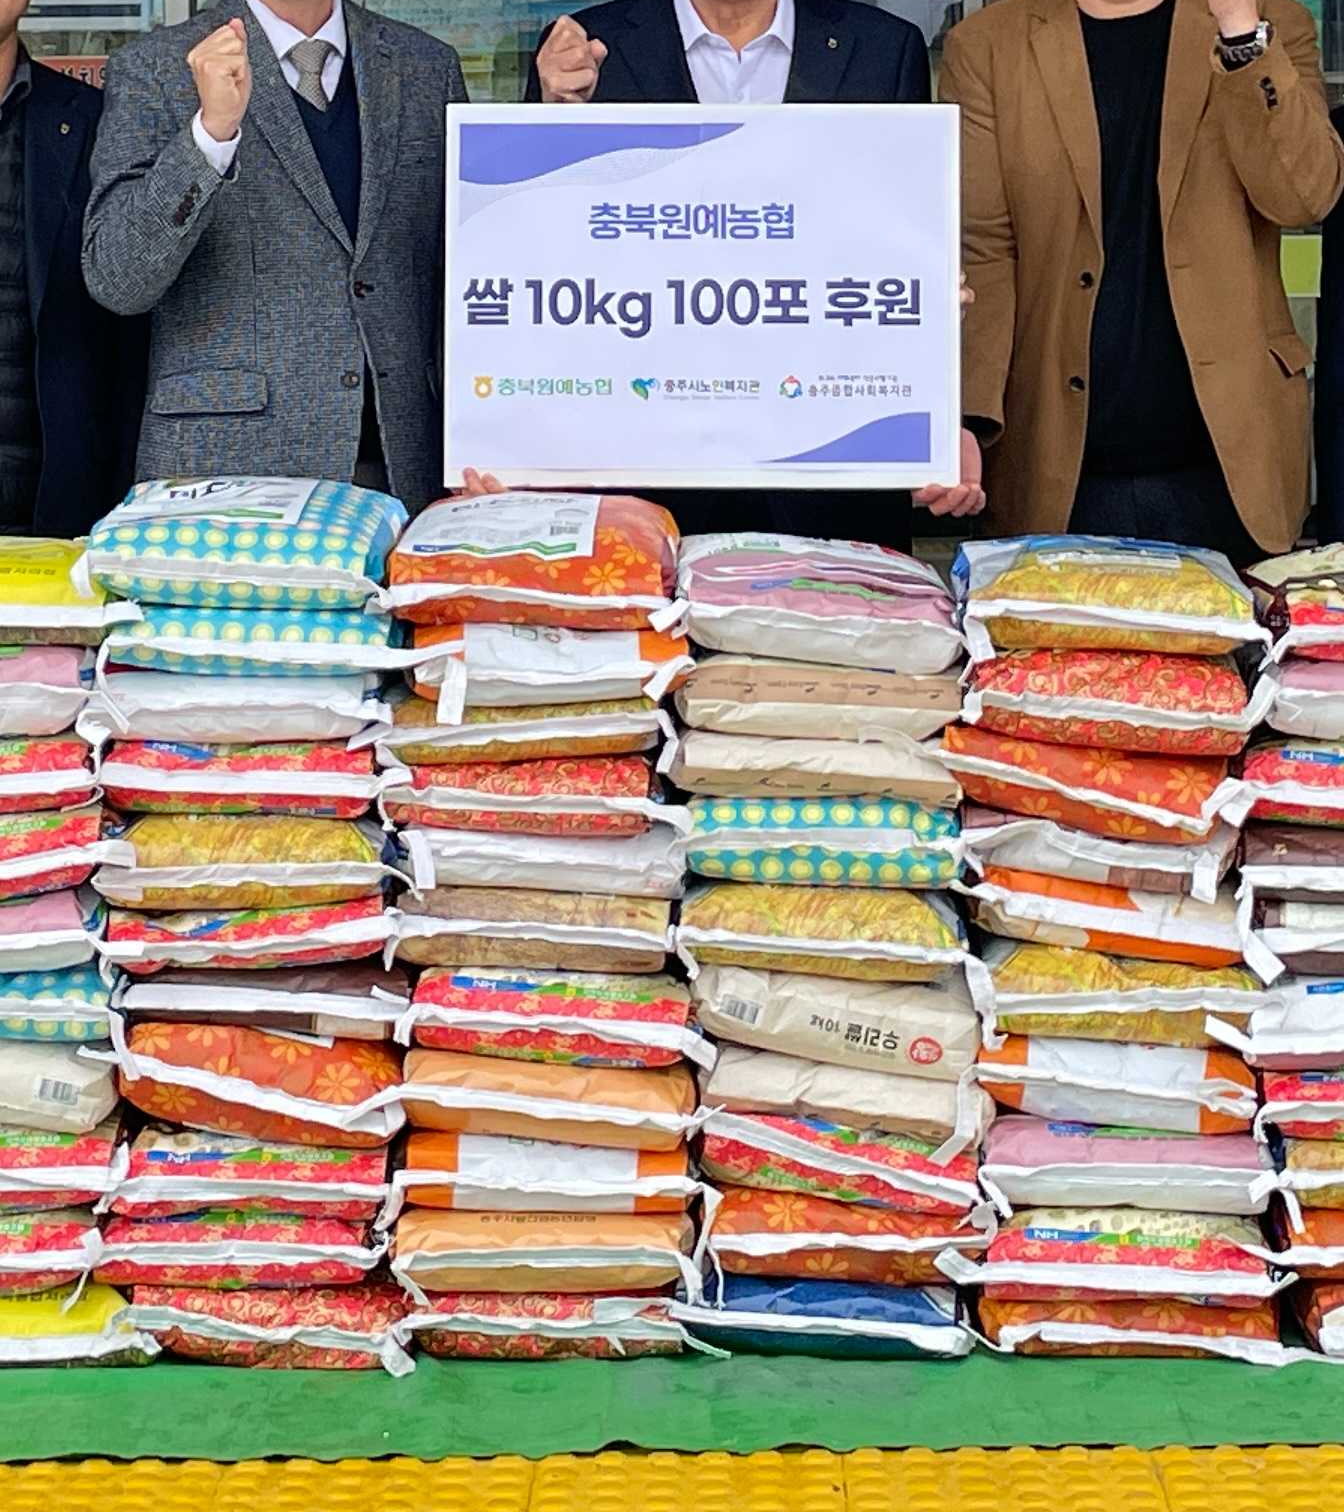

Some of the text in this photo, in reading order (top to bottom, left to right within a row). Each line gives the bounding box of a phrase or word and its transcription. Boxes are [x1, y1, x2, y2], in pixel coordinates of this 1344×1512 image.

[587, 201, 796, 241] 충북원예농협
[462, 276, 923, 339] 쌀 10kg 100포 후원
[497, 376, 614, 397] 충북원예농협
[662, 377, 761, 395] 충주시노인복지관
[1032, 1229, 1060, 1240] NH
